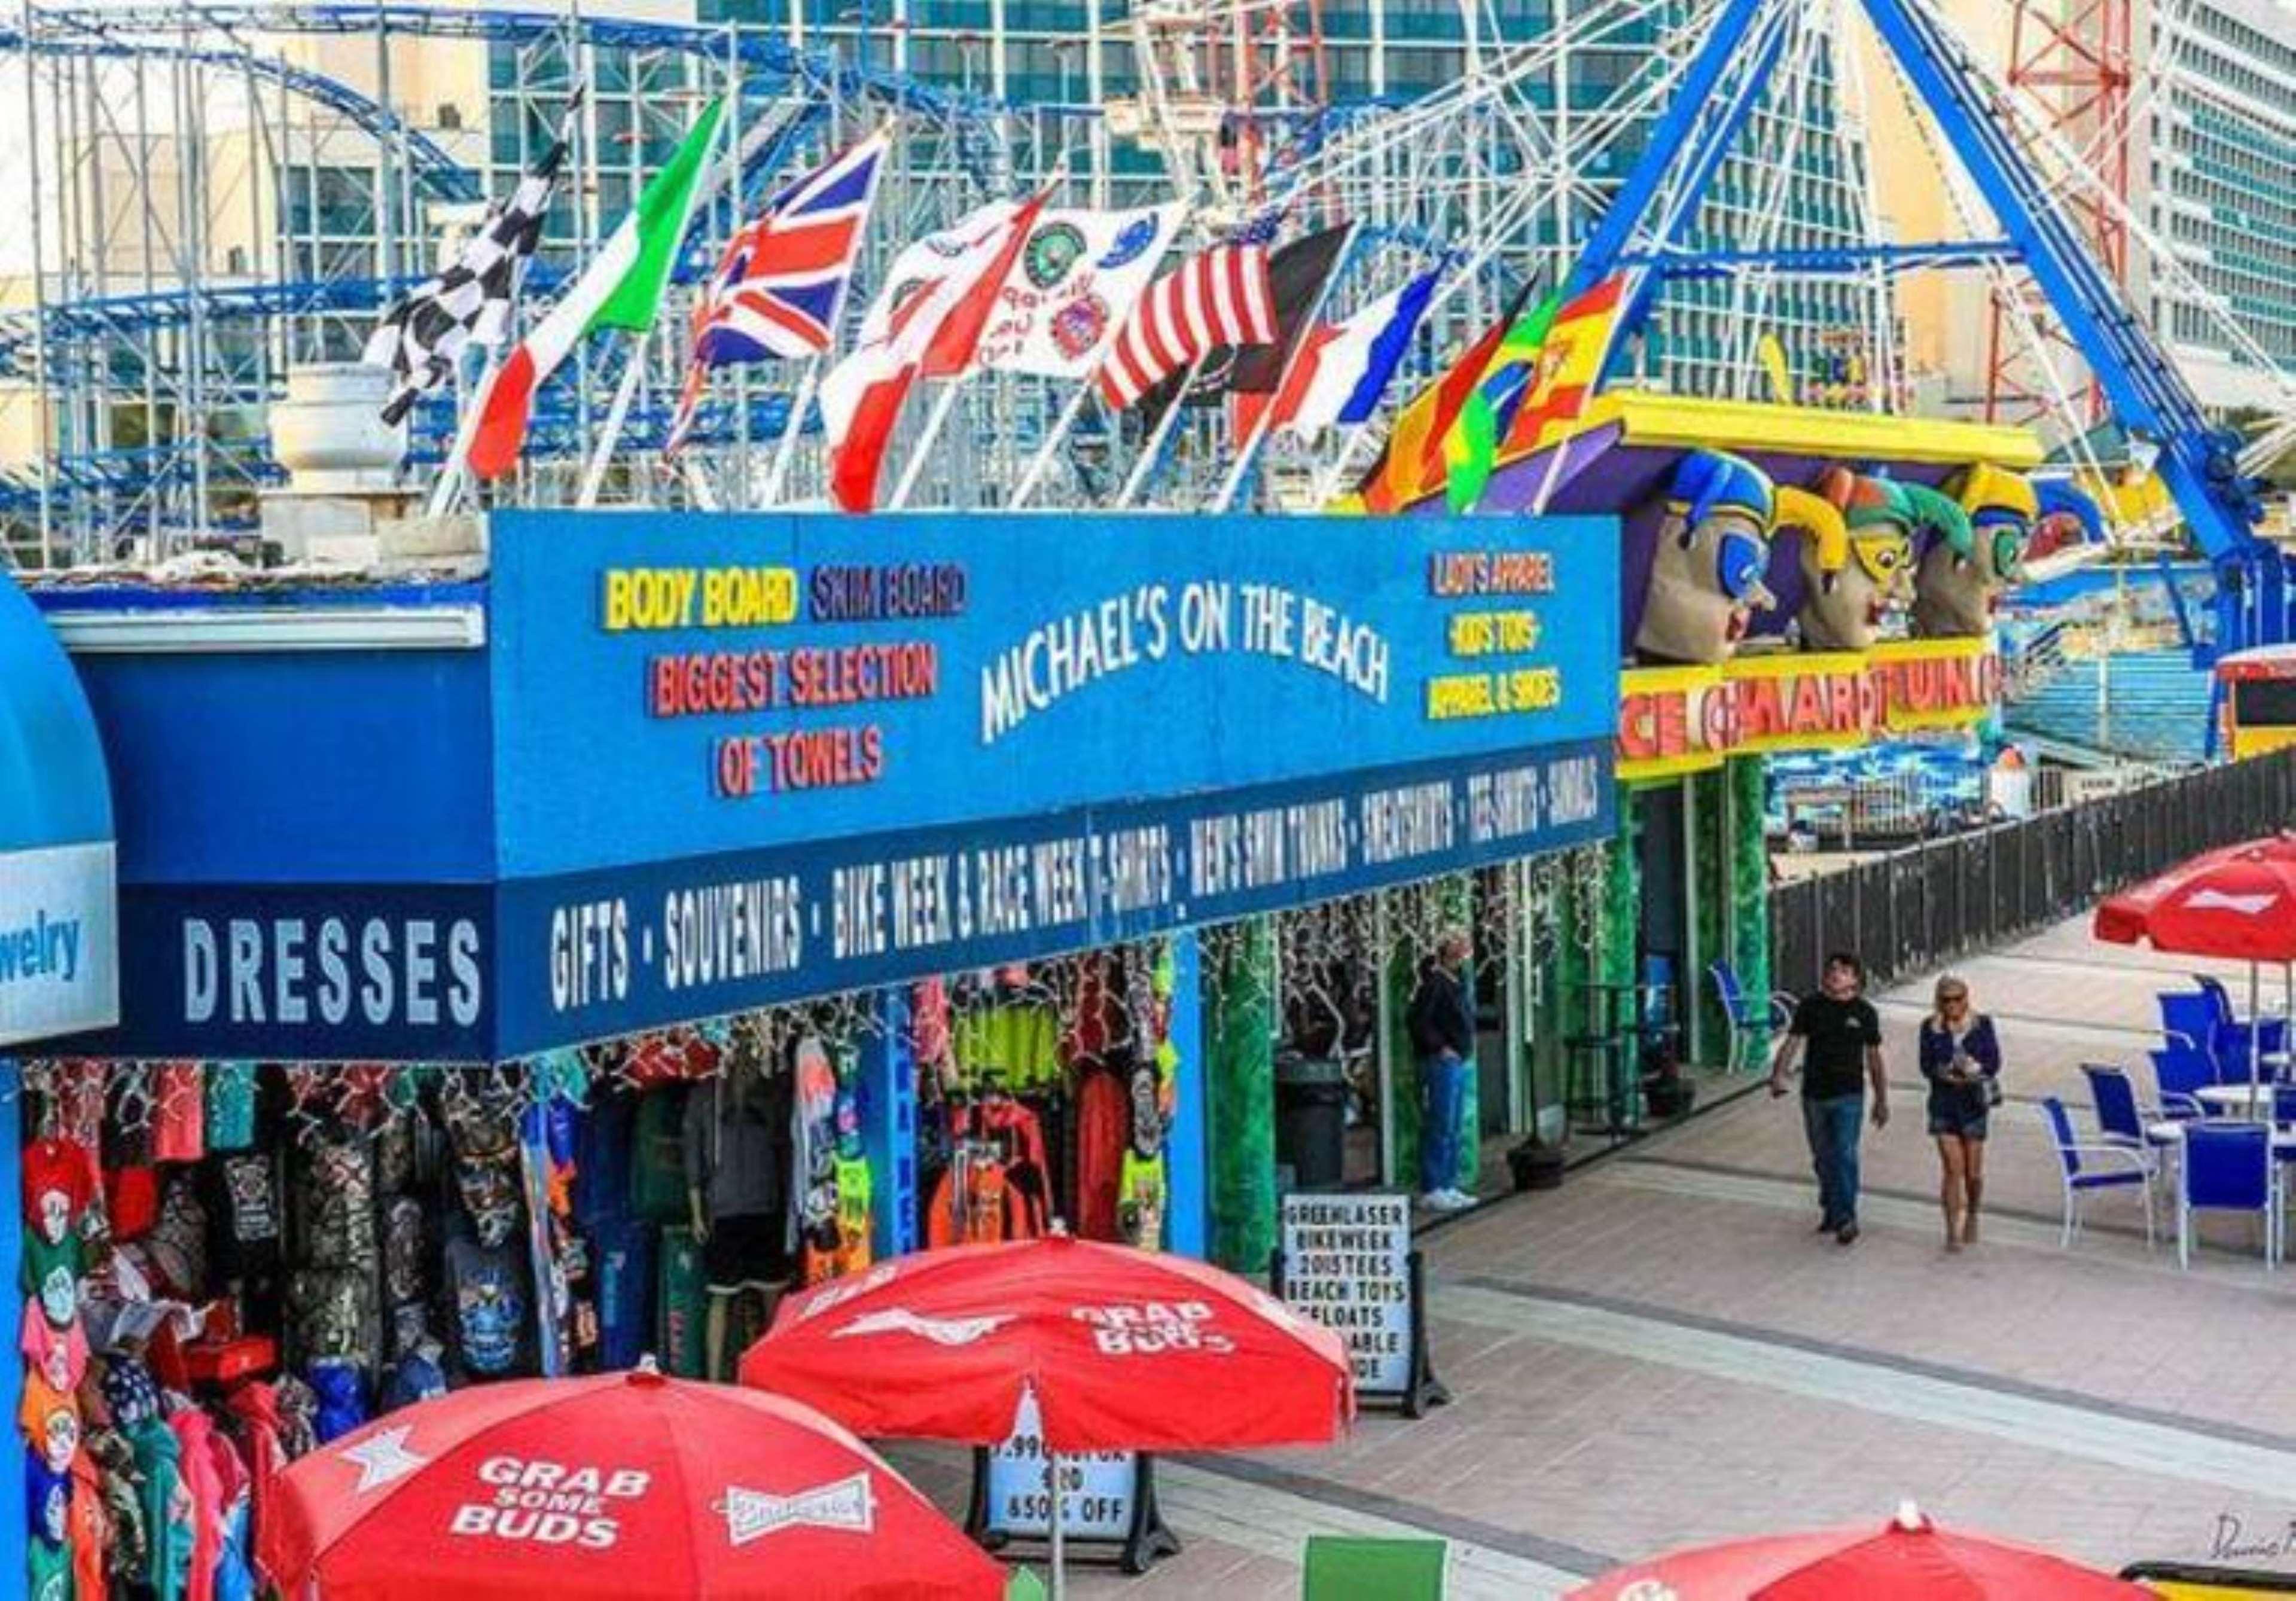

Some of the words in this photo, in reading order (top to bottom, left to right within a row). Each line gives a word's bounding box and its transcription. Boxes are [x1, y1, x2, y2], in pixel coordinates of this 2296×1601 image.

[604, 568, 697, 629] BODY
[701, 567, 798, 628] BOARD
[809, 565, 882, 622] SKIM
[884, 560, 968, 618] BOARD
[651, 649, 785, 716] BIGGEST
[788, 641, 938, 707] SELECTION
[981, 585, 1169, 744] MICHAEL'S
[1179, 580, 1230, 653] ON
[1240, 585, 1295, 658] THE
[1301, 597, 1389, 705] BEACH
[715, 734, 763, 797] OF
[766, 722, 884, 792] TOWELS
[0, 909, 80, 982] welry
[550, 897, 628, 1013] GIFTS
[665, 873, 801, 992] SOUVENIRS
[833, 862, 885, 959] BIKE
[892, 854, 952, 950] WEEK
[977, 844, 1030, 935] RACE
[1033, 836, 1087, 926] WEEK
[183, 917, 480, 1025] DRESSES
[1288, 1279, 1349, 1301] BEACH
[1349, 1331, 1399, 1354] ABLE
[480, 1456, 651, 1498] GRAB
[493, 1487, 608, 1515] SOME
[1081, 1495, 1124, 1523] OFF
[450, 1504, 621, 1549] BUDS
